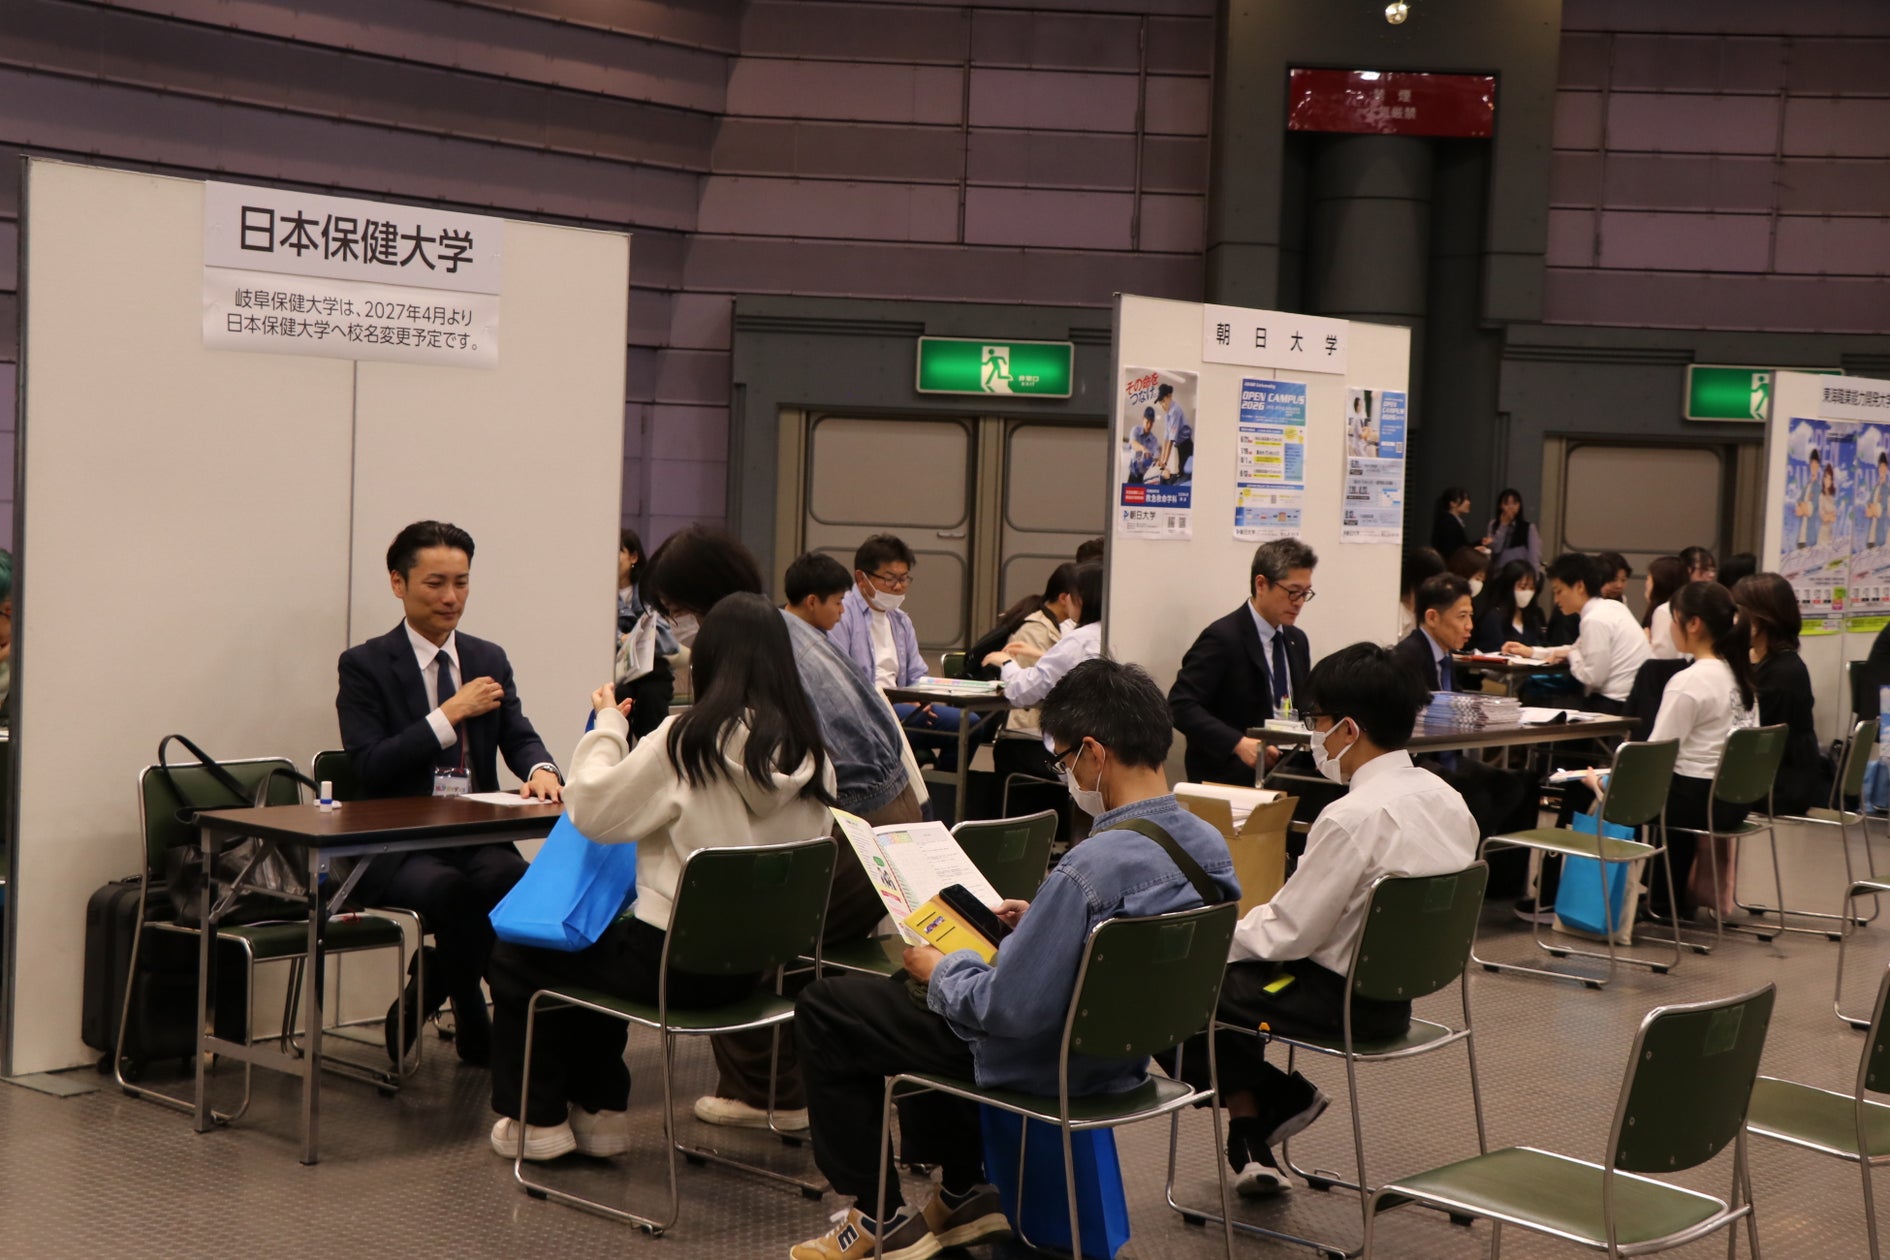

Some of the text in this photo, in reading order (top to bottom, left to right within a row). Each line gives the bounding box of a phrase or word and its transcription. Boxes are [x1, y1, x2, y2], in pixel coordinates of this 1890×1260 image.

[240, 205, 474, 274] 日本保健大学
[226, 313, 478, 351] 日本保健大学へ校名変更予定です。
[1241, 400, 1266, 411] 2026
[1242, 391, 1306, 405] OPEN CAMPUS
